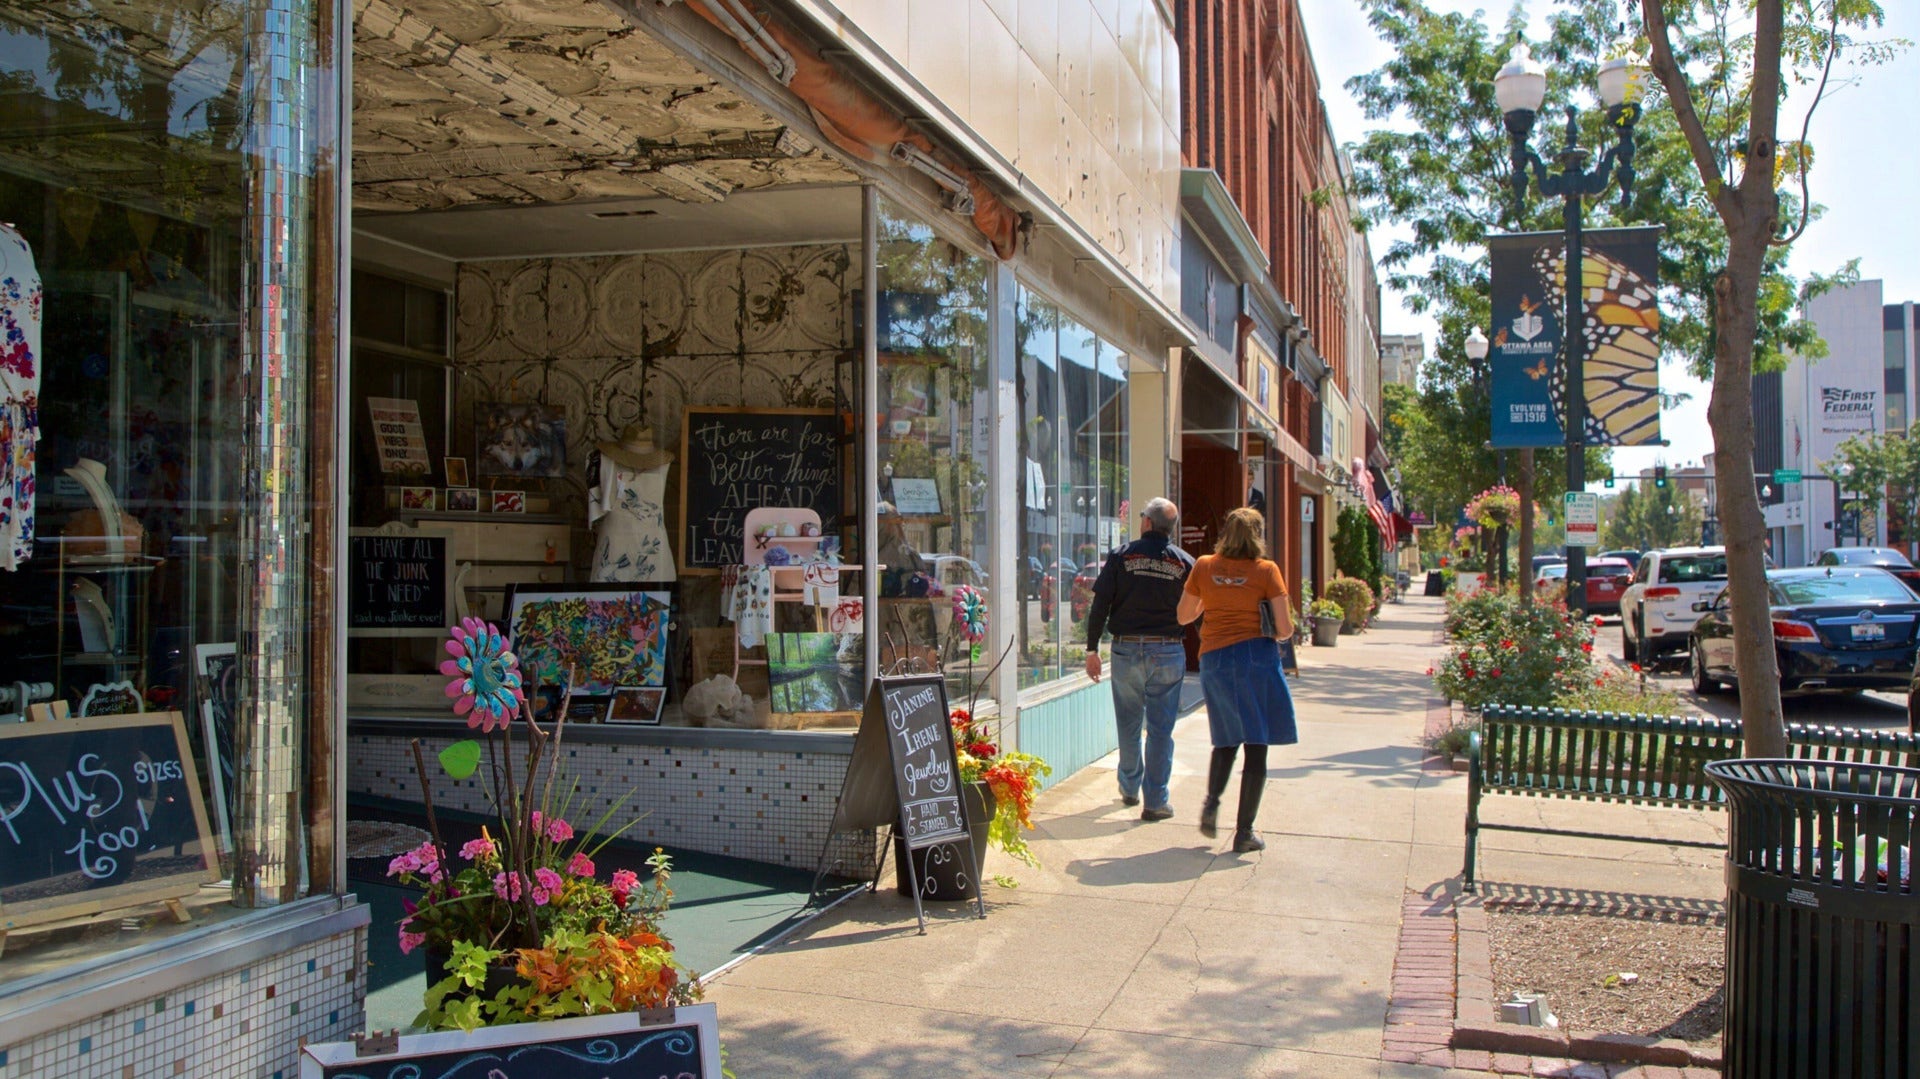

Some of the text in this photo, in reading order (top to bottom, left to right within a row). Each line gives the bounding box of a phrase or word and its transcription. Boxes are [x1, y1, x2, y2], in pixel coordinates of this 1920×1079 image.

[1841, 389, 1877, 401] FIRST
[1509, 403, 1547, 412] EVOLVING
[1524, 412, 1547, 423] 1916
[380, 423, 405, 434] GOOD
[695, 421, 837, 453] there are far
[383, 435, 409, 447] VIBES
[704, 448, 774, 486] Better
[720, 483, 815, 508] AHEAD
[707, 511, 745, 538] tha
[373, 538, 407, 559] HAVE
[413, 538, 436, 559] ALL
[690, 526, 745, 564] LEAV
[364, 561, 430, 581] THE JUNK
[367, 583, 376, 603] I
[904, 749, 952, 796] Jewelry
[0, 753, 183, 845] Plus SIZES
[920, 802, 939, 818] HAND
[919, 815, 948, 834] STAMPED
[65, 799, 156, 879] too!
